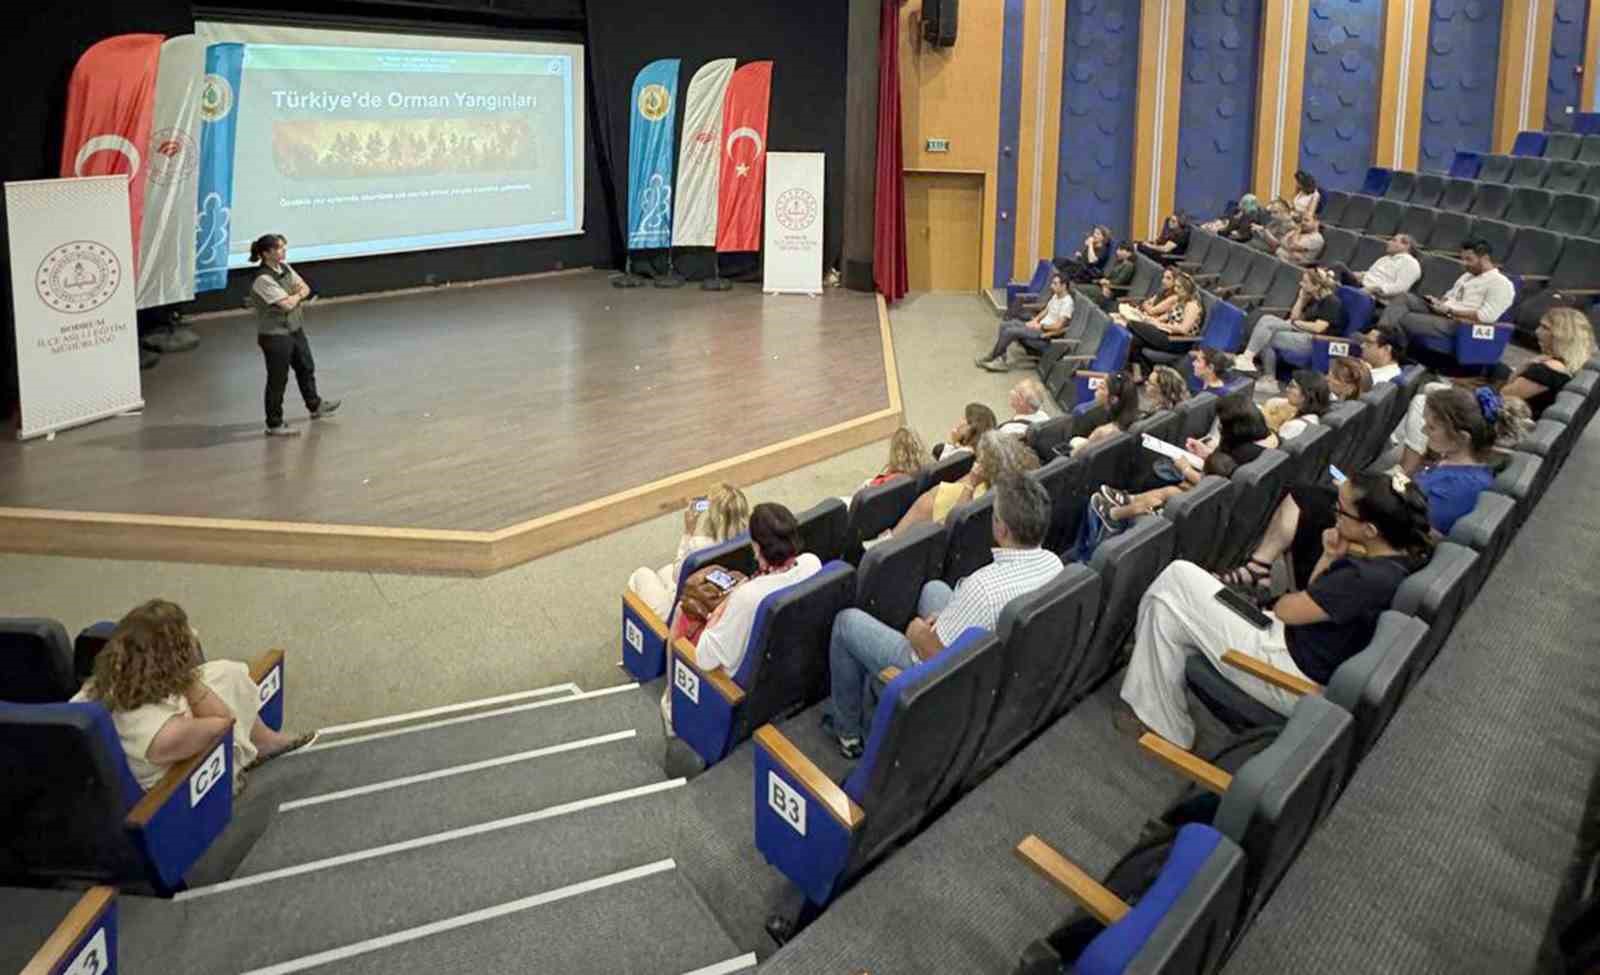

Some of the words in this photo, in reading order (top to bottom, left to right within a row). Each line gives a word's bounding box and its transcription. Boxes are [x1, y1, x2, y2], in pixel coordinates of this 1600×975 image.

[271, 90, 382, 112] Türkiye'de
[388, 91, 449, 108] Orman
[454, 91, 537, 111] Yangınları
[1474, 325, 1491, 337] A4
[628, 625, 641, 648] B1
[259, 672, 277, 700] C1
[678, 667, 696, 697] B2
[195, 757, 221, 794] C2
[773, 783, 800, 824] B3
